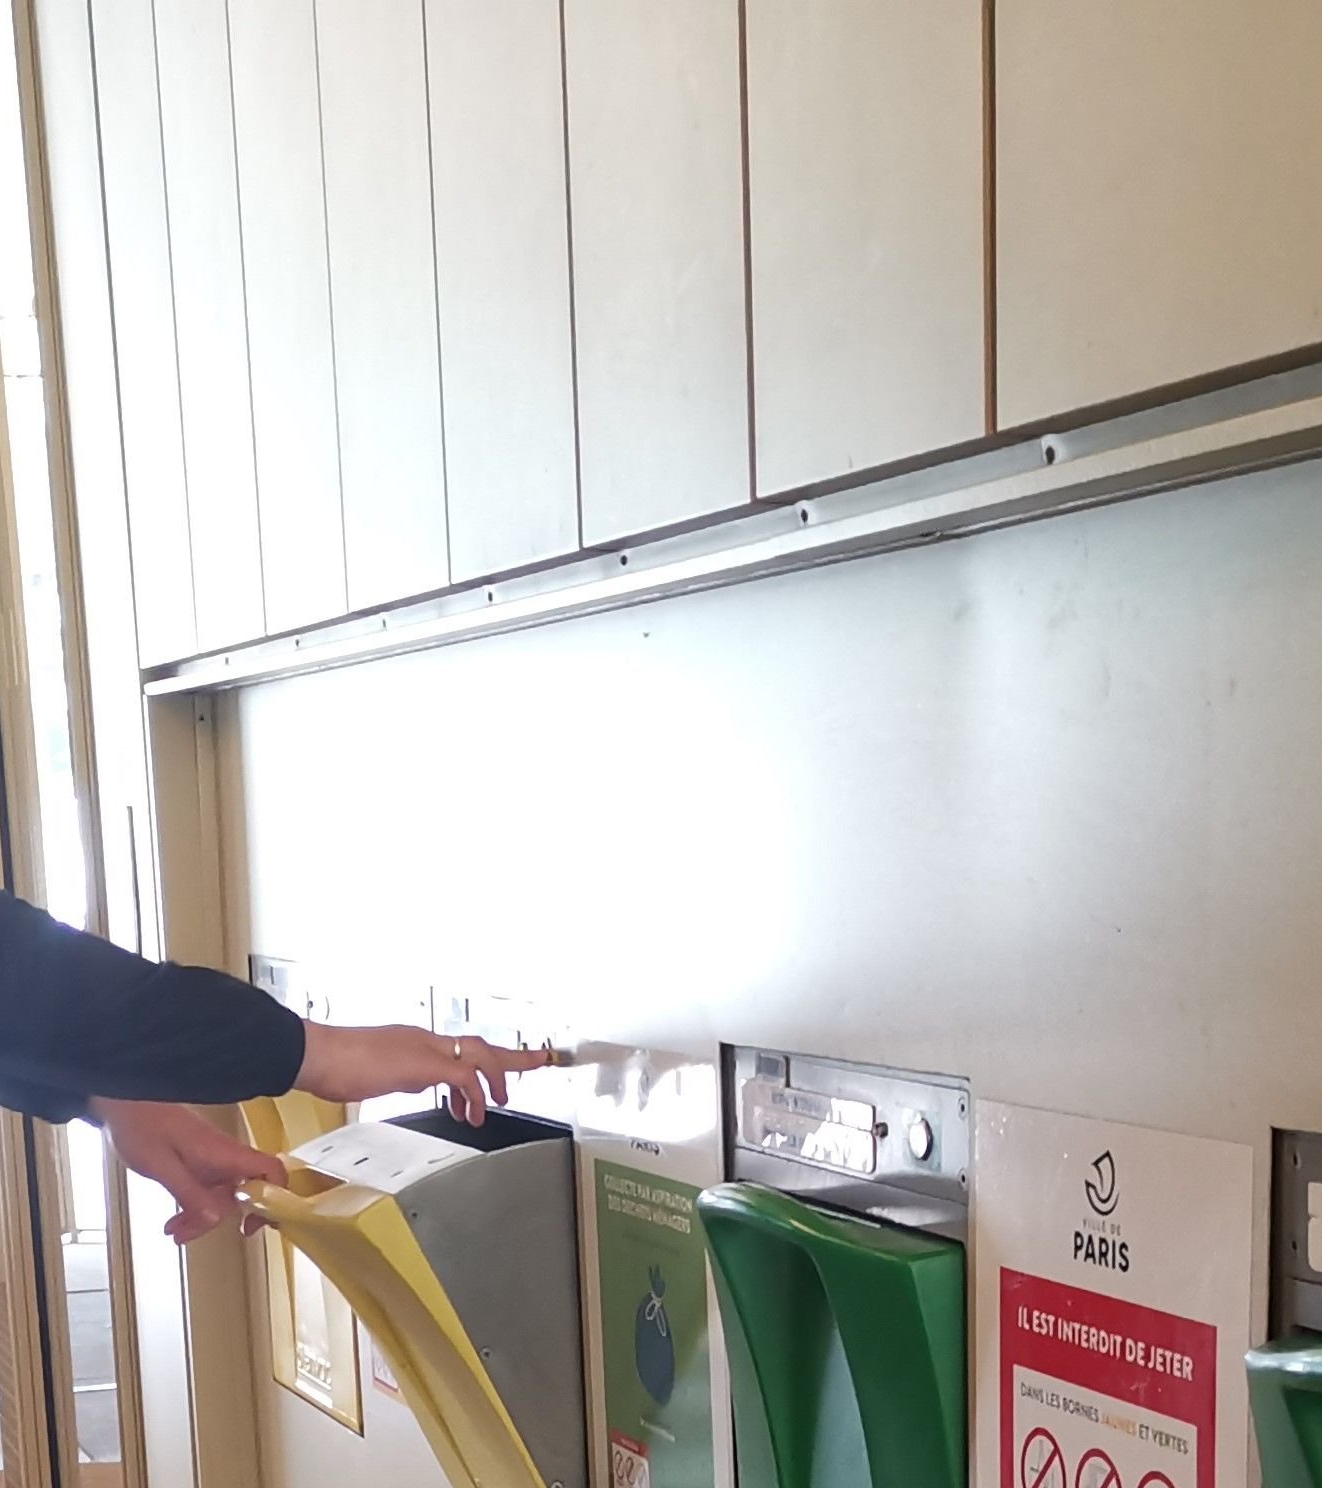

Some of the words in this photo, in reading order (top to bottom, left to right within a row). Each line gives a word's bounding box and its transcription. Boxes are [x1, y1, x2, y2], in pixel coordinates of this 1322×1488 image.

[1073, 1230, 1130, 1273] PARIS
[1083, 1218, 1106, 1232] VILLE
[1110, 1223, 1121, 1236] DE
[1018, 1305, 1029, 1331] IL
[1032, 1309, 1055, 1336] EST
[1057, 1317, 1123, 1360] INTERDIT
[1125, 1337, 1146, 1367] DE
[1147, 1345, 1194, 1382] JETER
[1020, 1381, 1044, 1404] DANS
[1045, 1391, 1061, 1411] LES
[1062, 1397, 1099, 1424] BORNES
[1100, 1412, 1136, 1437] JAUNES
[1138, 1423, 1150, 1441] ET
[1151, 1427, 1189, 1455] VERTES
